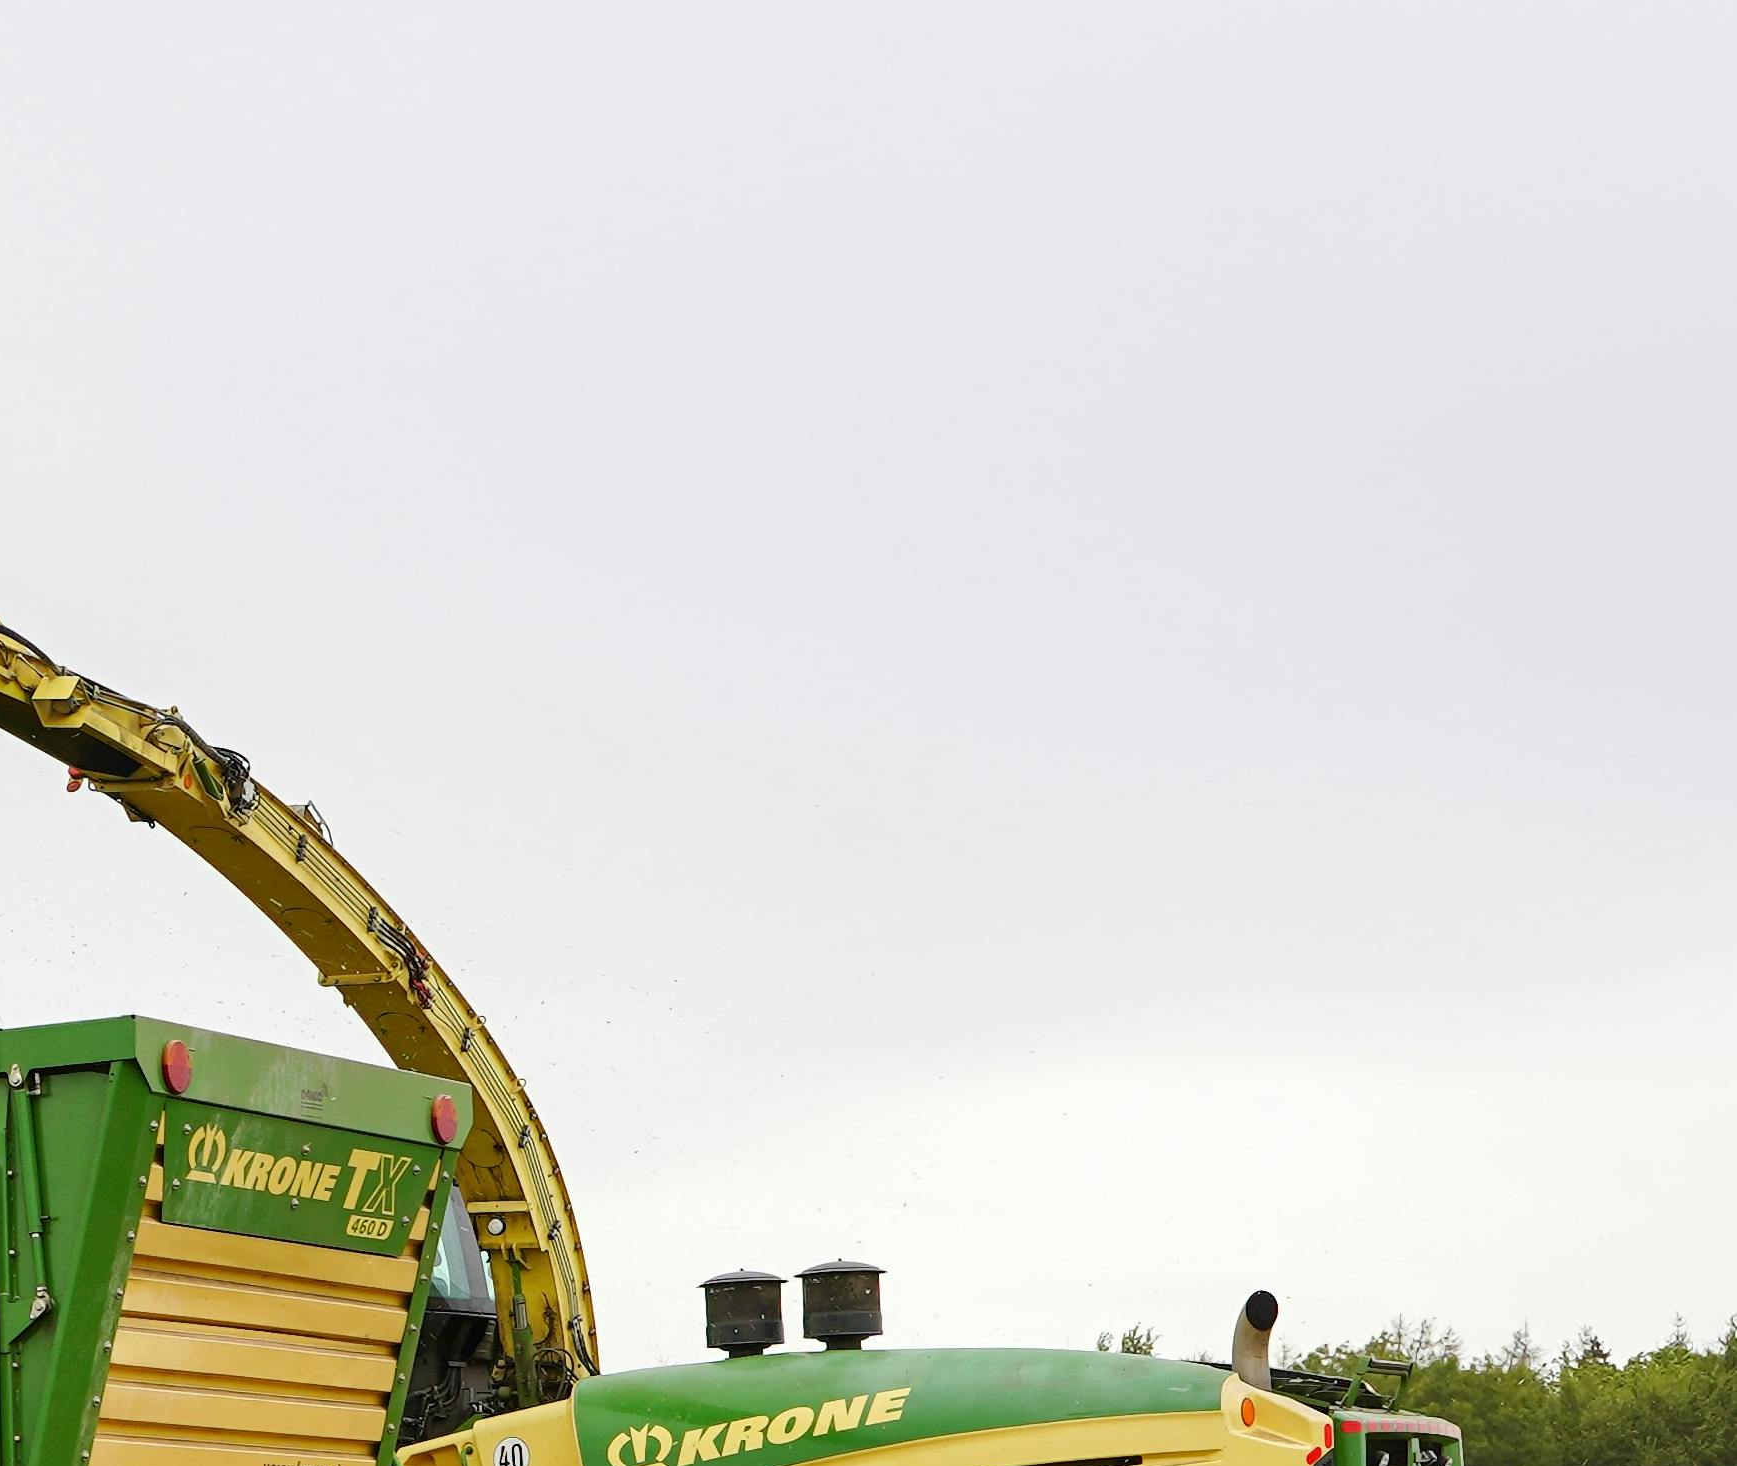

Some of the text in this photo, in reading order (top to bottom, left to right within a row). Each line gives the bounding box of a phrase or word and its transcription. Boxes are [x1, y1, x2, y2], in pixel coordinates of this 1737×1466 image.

[220, 1149, 342, 1201] KRONE
[343, 1148, 412, 1216] TX
[351, 1218, 388, 1237] 460 D
